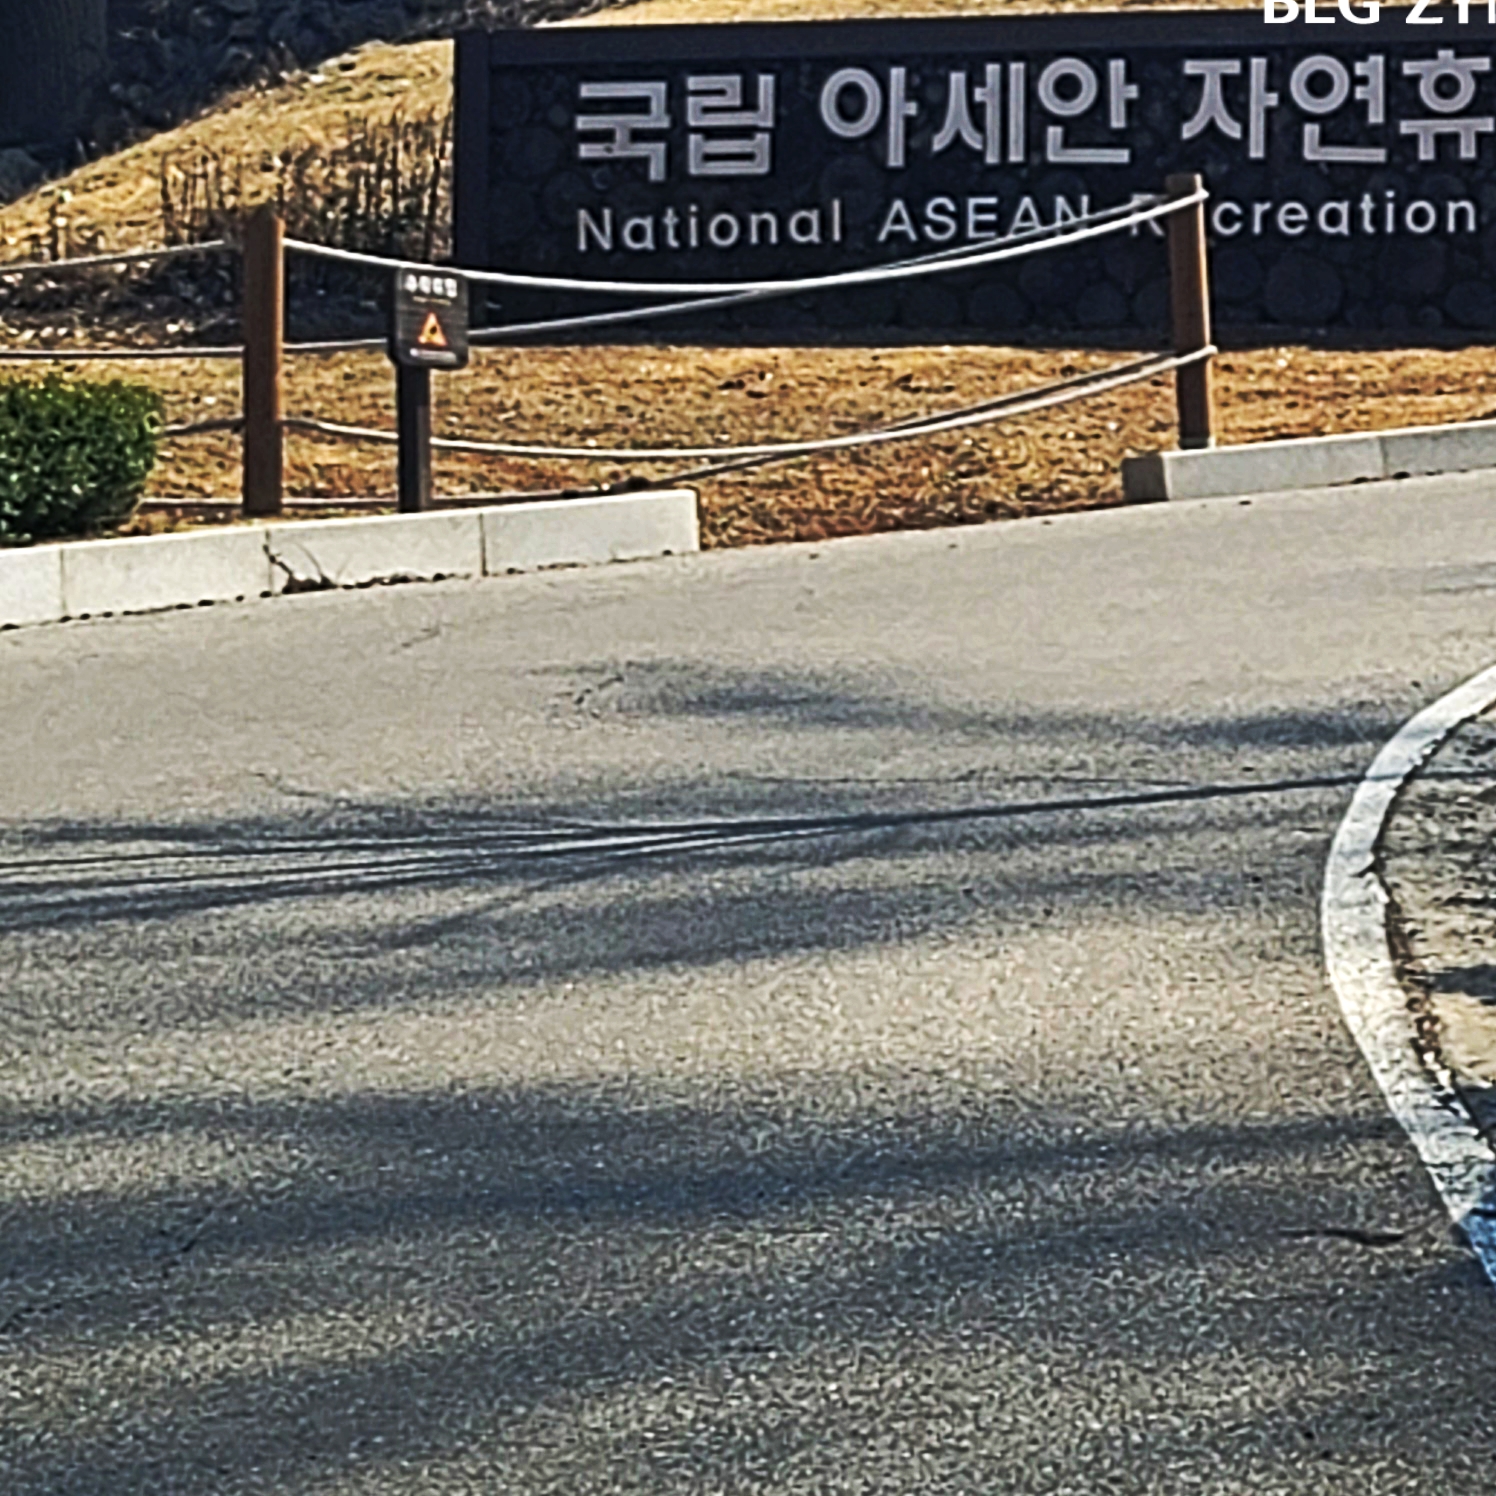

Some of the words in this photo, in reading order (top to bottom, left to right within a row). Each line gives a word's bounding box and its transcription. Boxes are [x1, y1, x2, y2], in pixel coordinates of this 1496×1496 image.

[575, 74, 775, 182] 국립
[819, 57, 1139, 167] 아세안
[577, 199, 842, 252] National
[878, 194, 1088, 243] ASEAN
[1130, 191, 1477, 237] Rcreation
